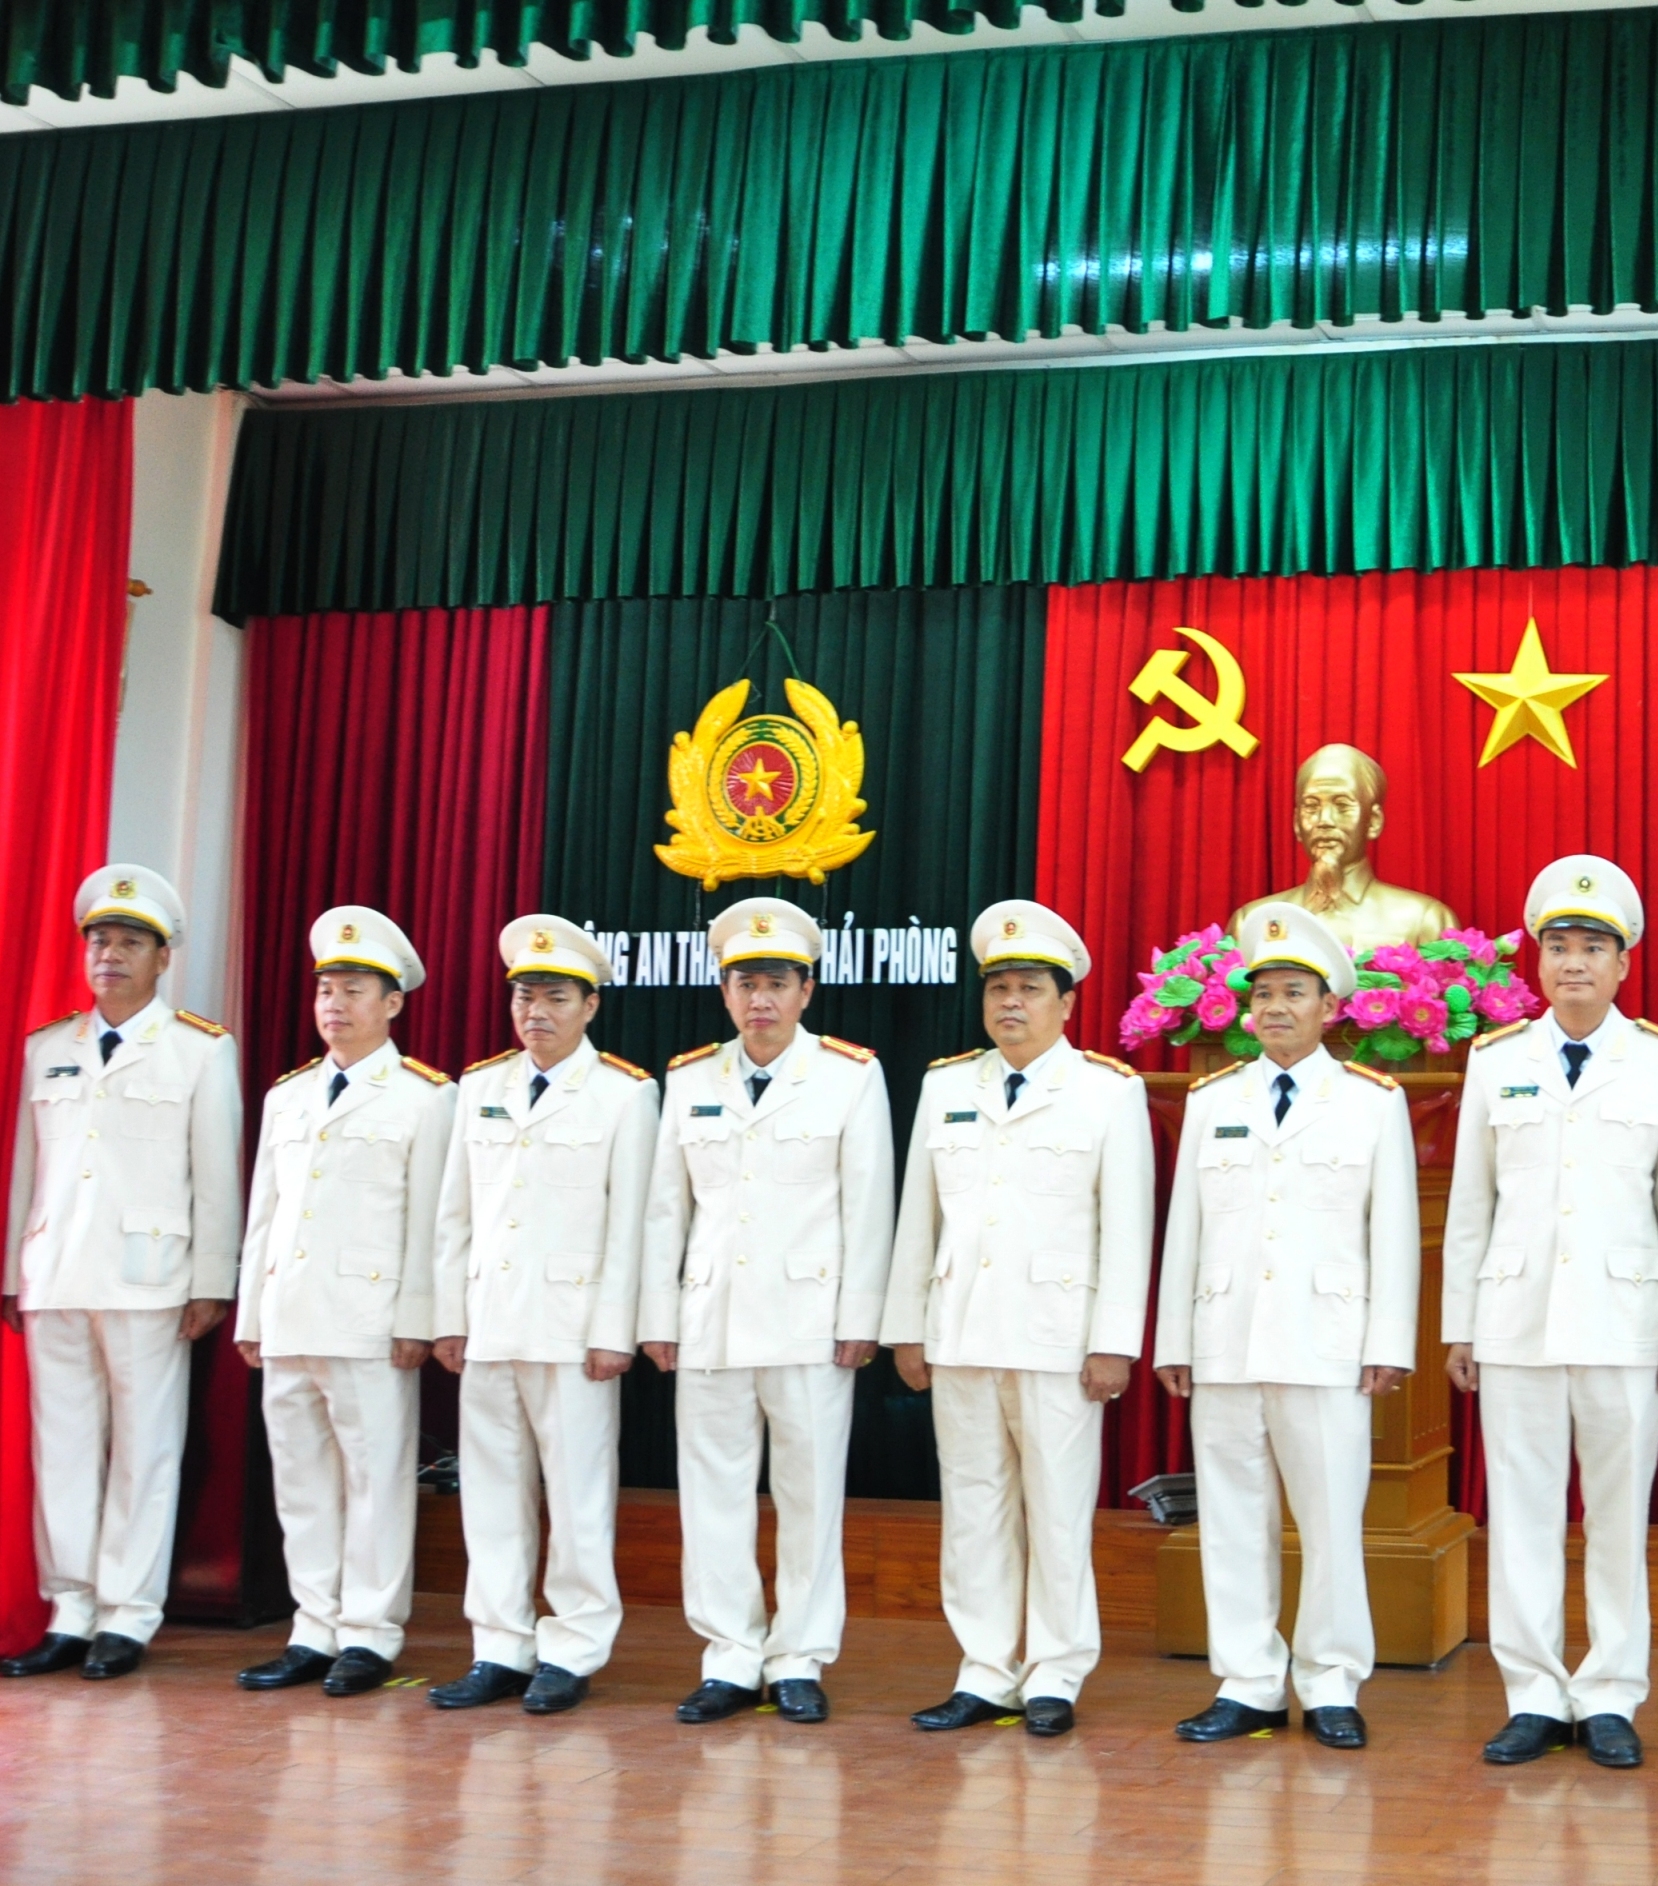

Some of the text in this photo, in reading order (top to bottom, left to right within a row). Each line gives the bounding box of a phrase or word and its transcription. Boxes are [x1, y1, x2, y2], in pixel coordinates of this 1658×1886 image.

[635, 931, 672, 986] AN
[819, 911, 865, 985] HẢI
[872, 915, 957, 985] PHÒNG
